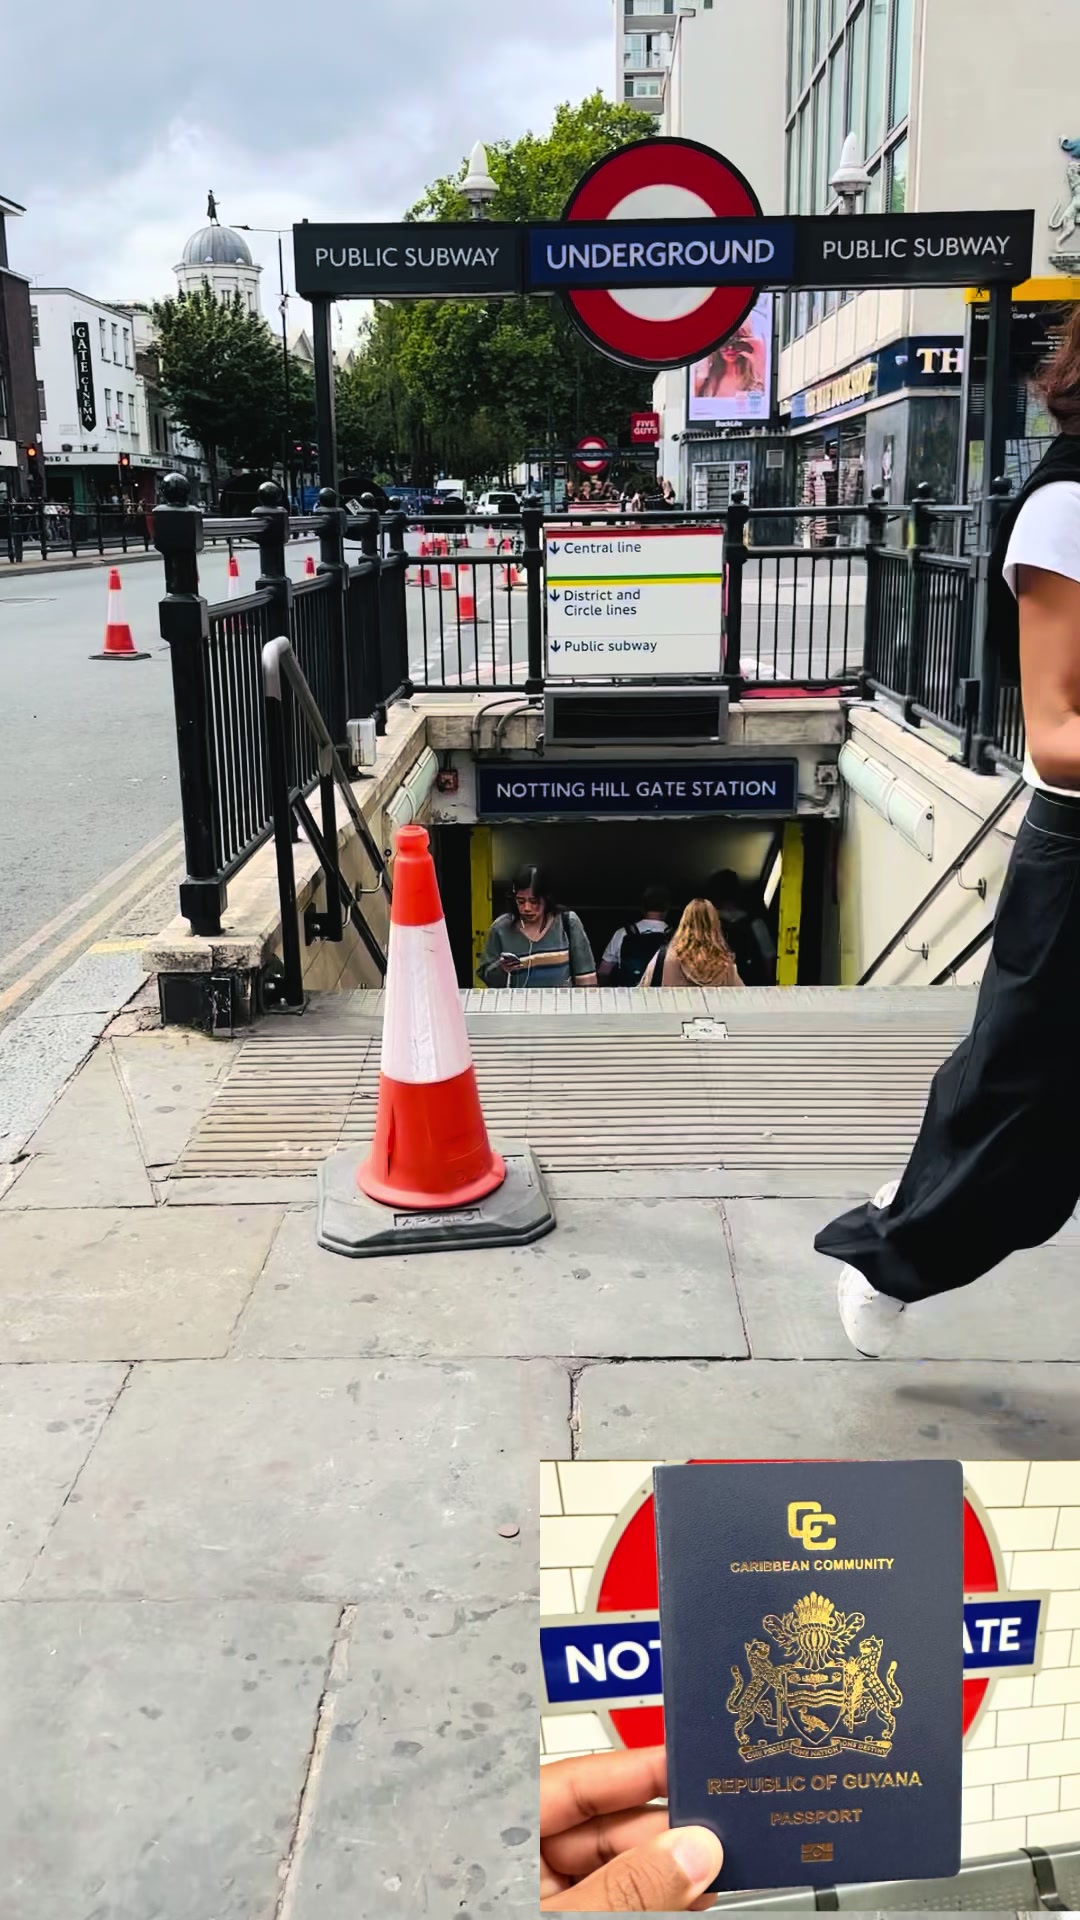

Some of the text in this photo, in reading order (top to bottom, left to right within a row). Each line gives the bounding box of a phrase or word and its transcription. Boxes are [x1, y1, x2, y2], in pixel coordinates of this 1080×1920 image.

[546, 238, 775, 270] UNDERGROUND
[822, 235, 1010, 260] PUBLIC SUBWAY
[315, 247, 500, 267] PUBLIC SUBWAY
[76, 326, 93, 422] GATE CINEMA
[635, 419, 655, 428] FIVE
[633, 427, 658, 436] GUYS
[564, 541, 642, 554] Central line
[564, 589, 641, 601] District and
[564, 604, 637, 616] Circle lines
[564, 640, 657, 653] Public subway
[497, 780, 777, 799] NOTTING HILL GATE STATION
[730, 1558, 895, 1573] CARIBBEAN COMMUNITY
[810, 1746, 839, 1757] NATION
[858, 1743, 887, 1756] DESTINY
[707, 1771, 923, 1795] REPUBLIC OF GUYANA
[770, 1808, 863, 1826] PASSPORT
